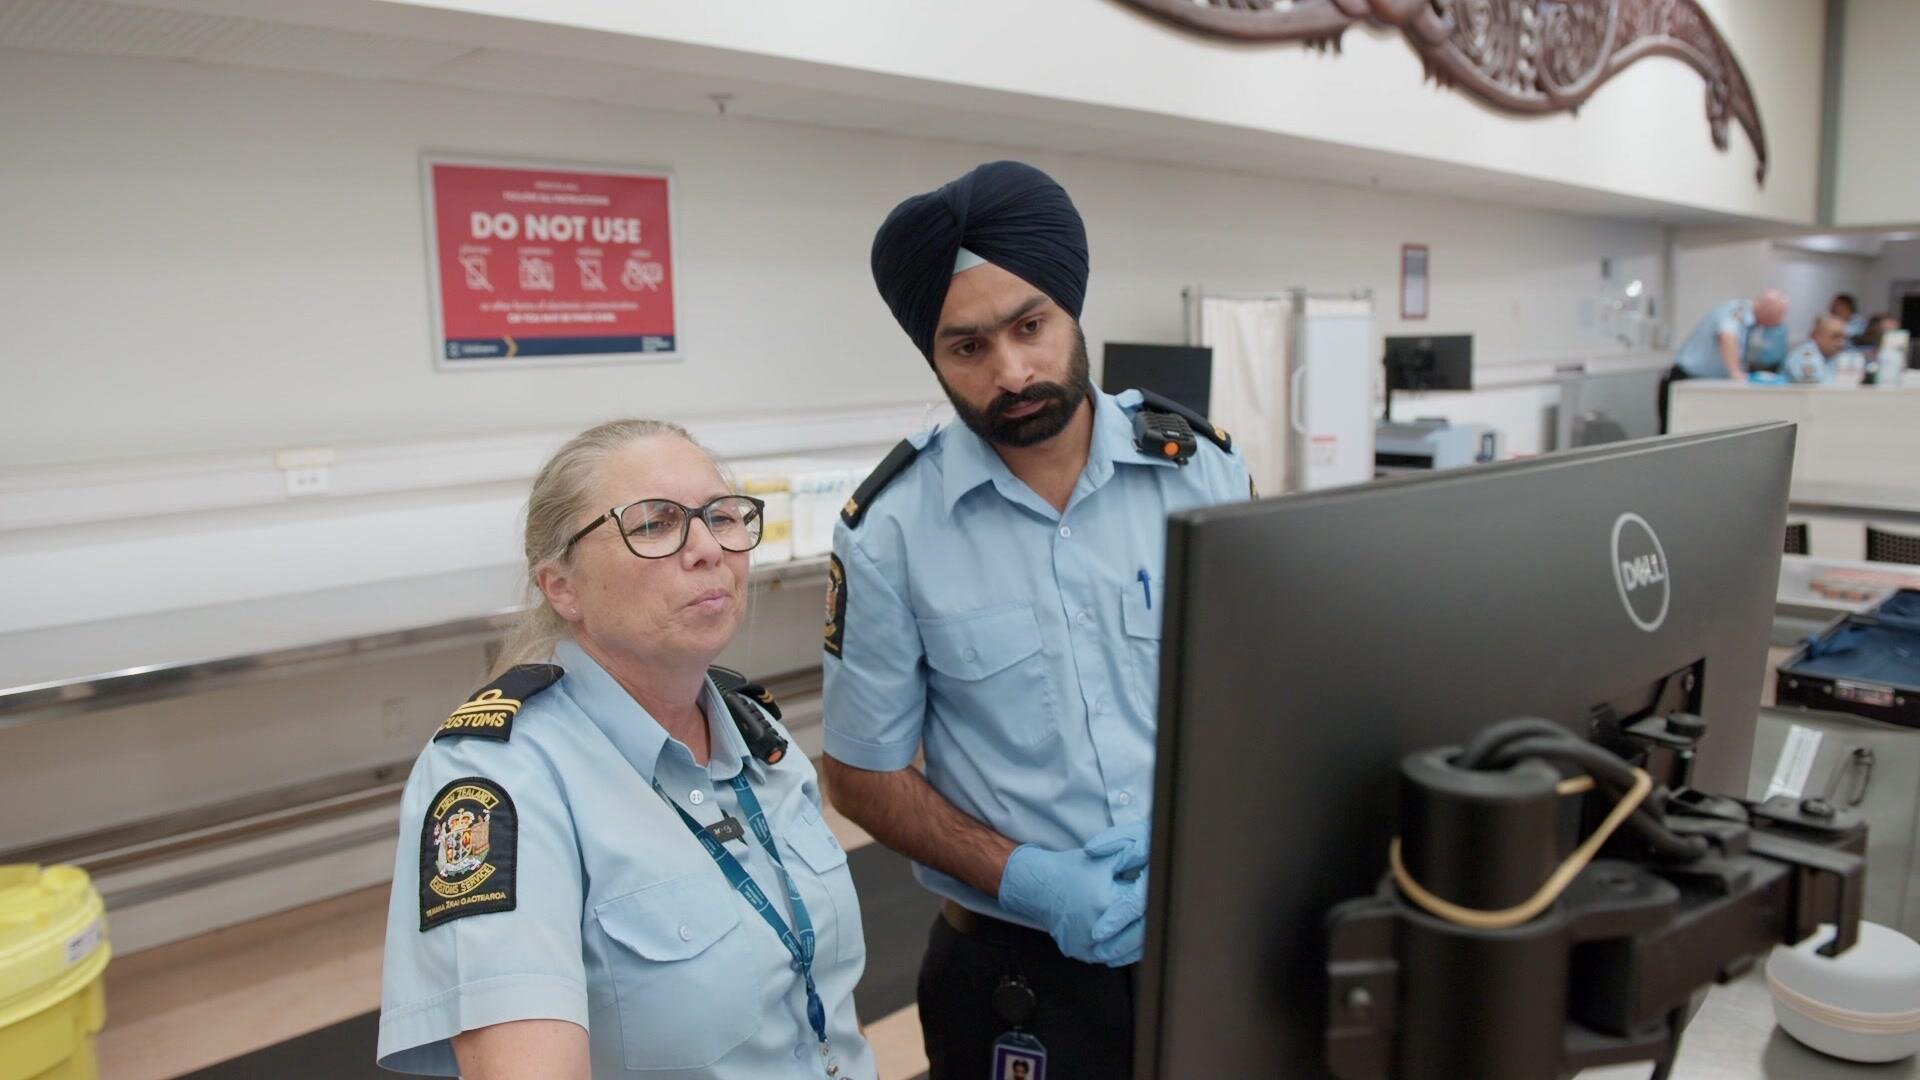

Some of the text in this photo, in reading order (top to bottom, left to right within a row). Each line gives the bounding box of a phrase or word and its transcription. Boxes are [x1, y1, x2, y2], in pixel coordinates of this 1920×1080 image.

[470, 211, 642, 244] DO NOT USE
[1621, 553, 1665, 591] DELL
[441, 788, 491, 809] NEW ZEALAND
[433, 867, 491, 894] CUSTOMS SERVICE
